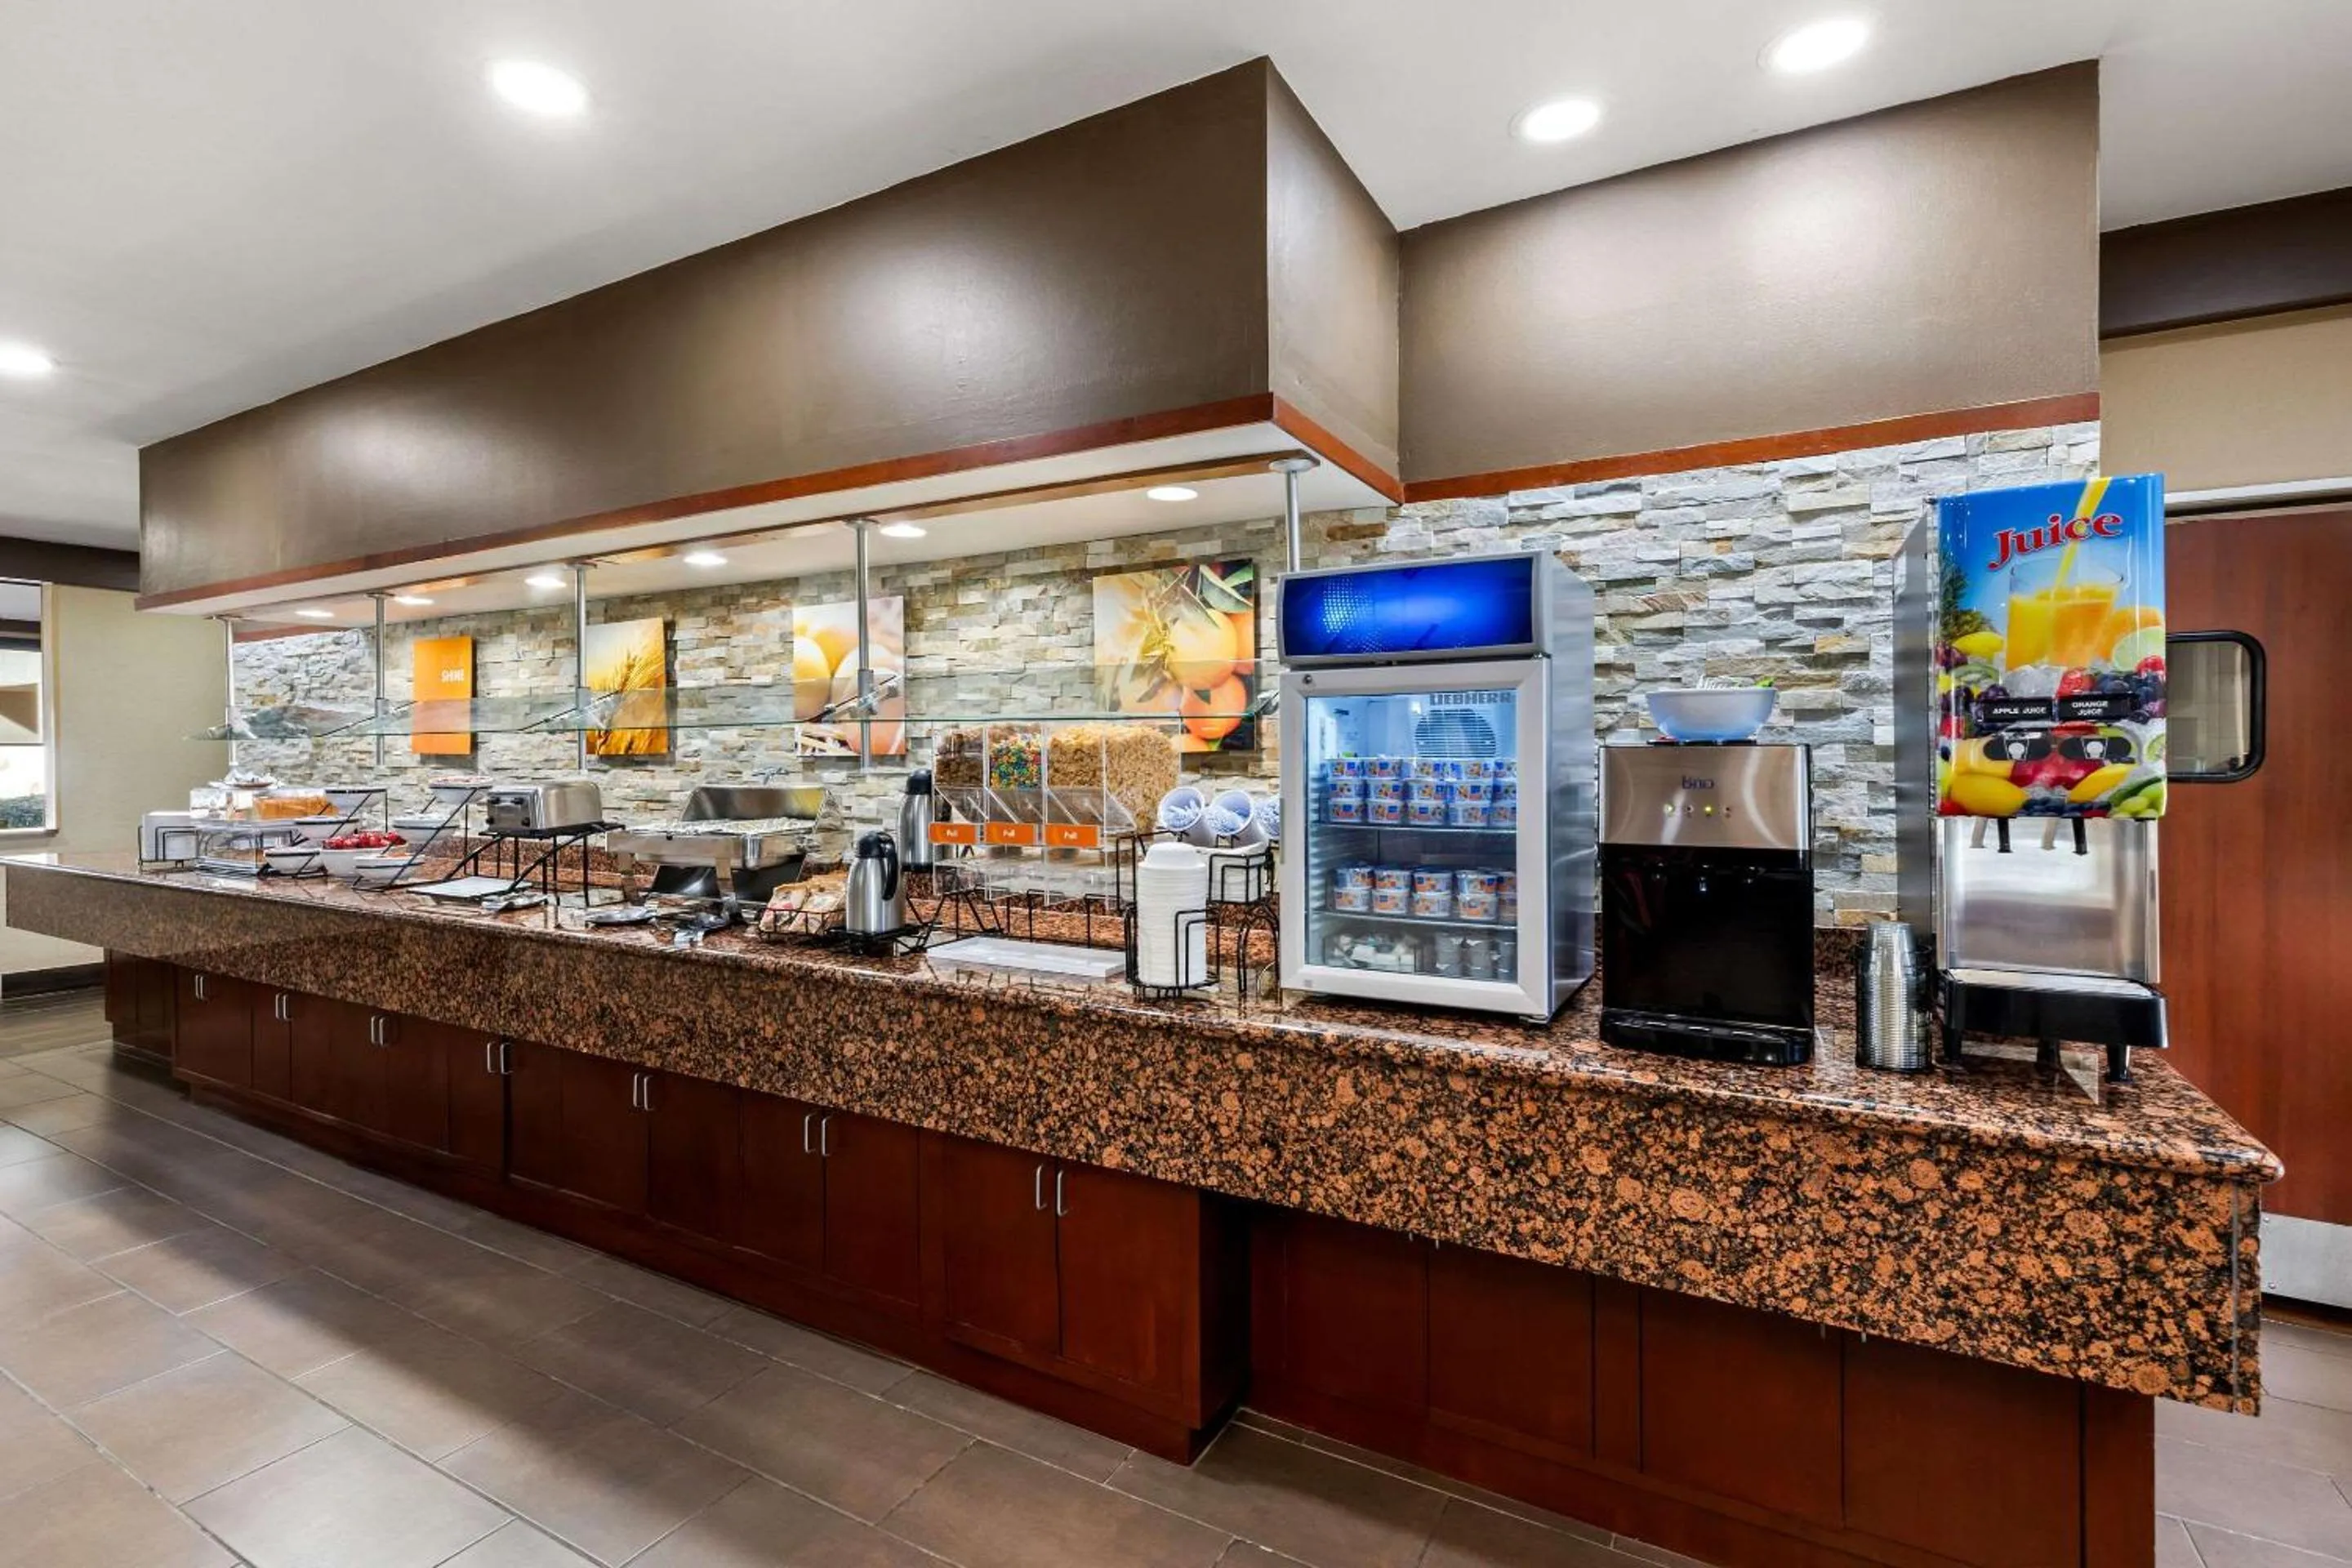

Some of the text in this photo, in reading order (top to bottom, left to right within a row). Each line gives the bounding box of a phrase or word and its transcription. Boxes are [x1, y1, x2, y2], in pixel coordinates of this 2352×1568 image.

[1987, 514, 2123, 570] Juice
[1993, 706, 2047, 715] APPLE JUICE
[2077, 708, 2104, 716] JUICE
